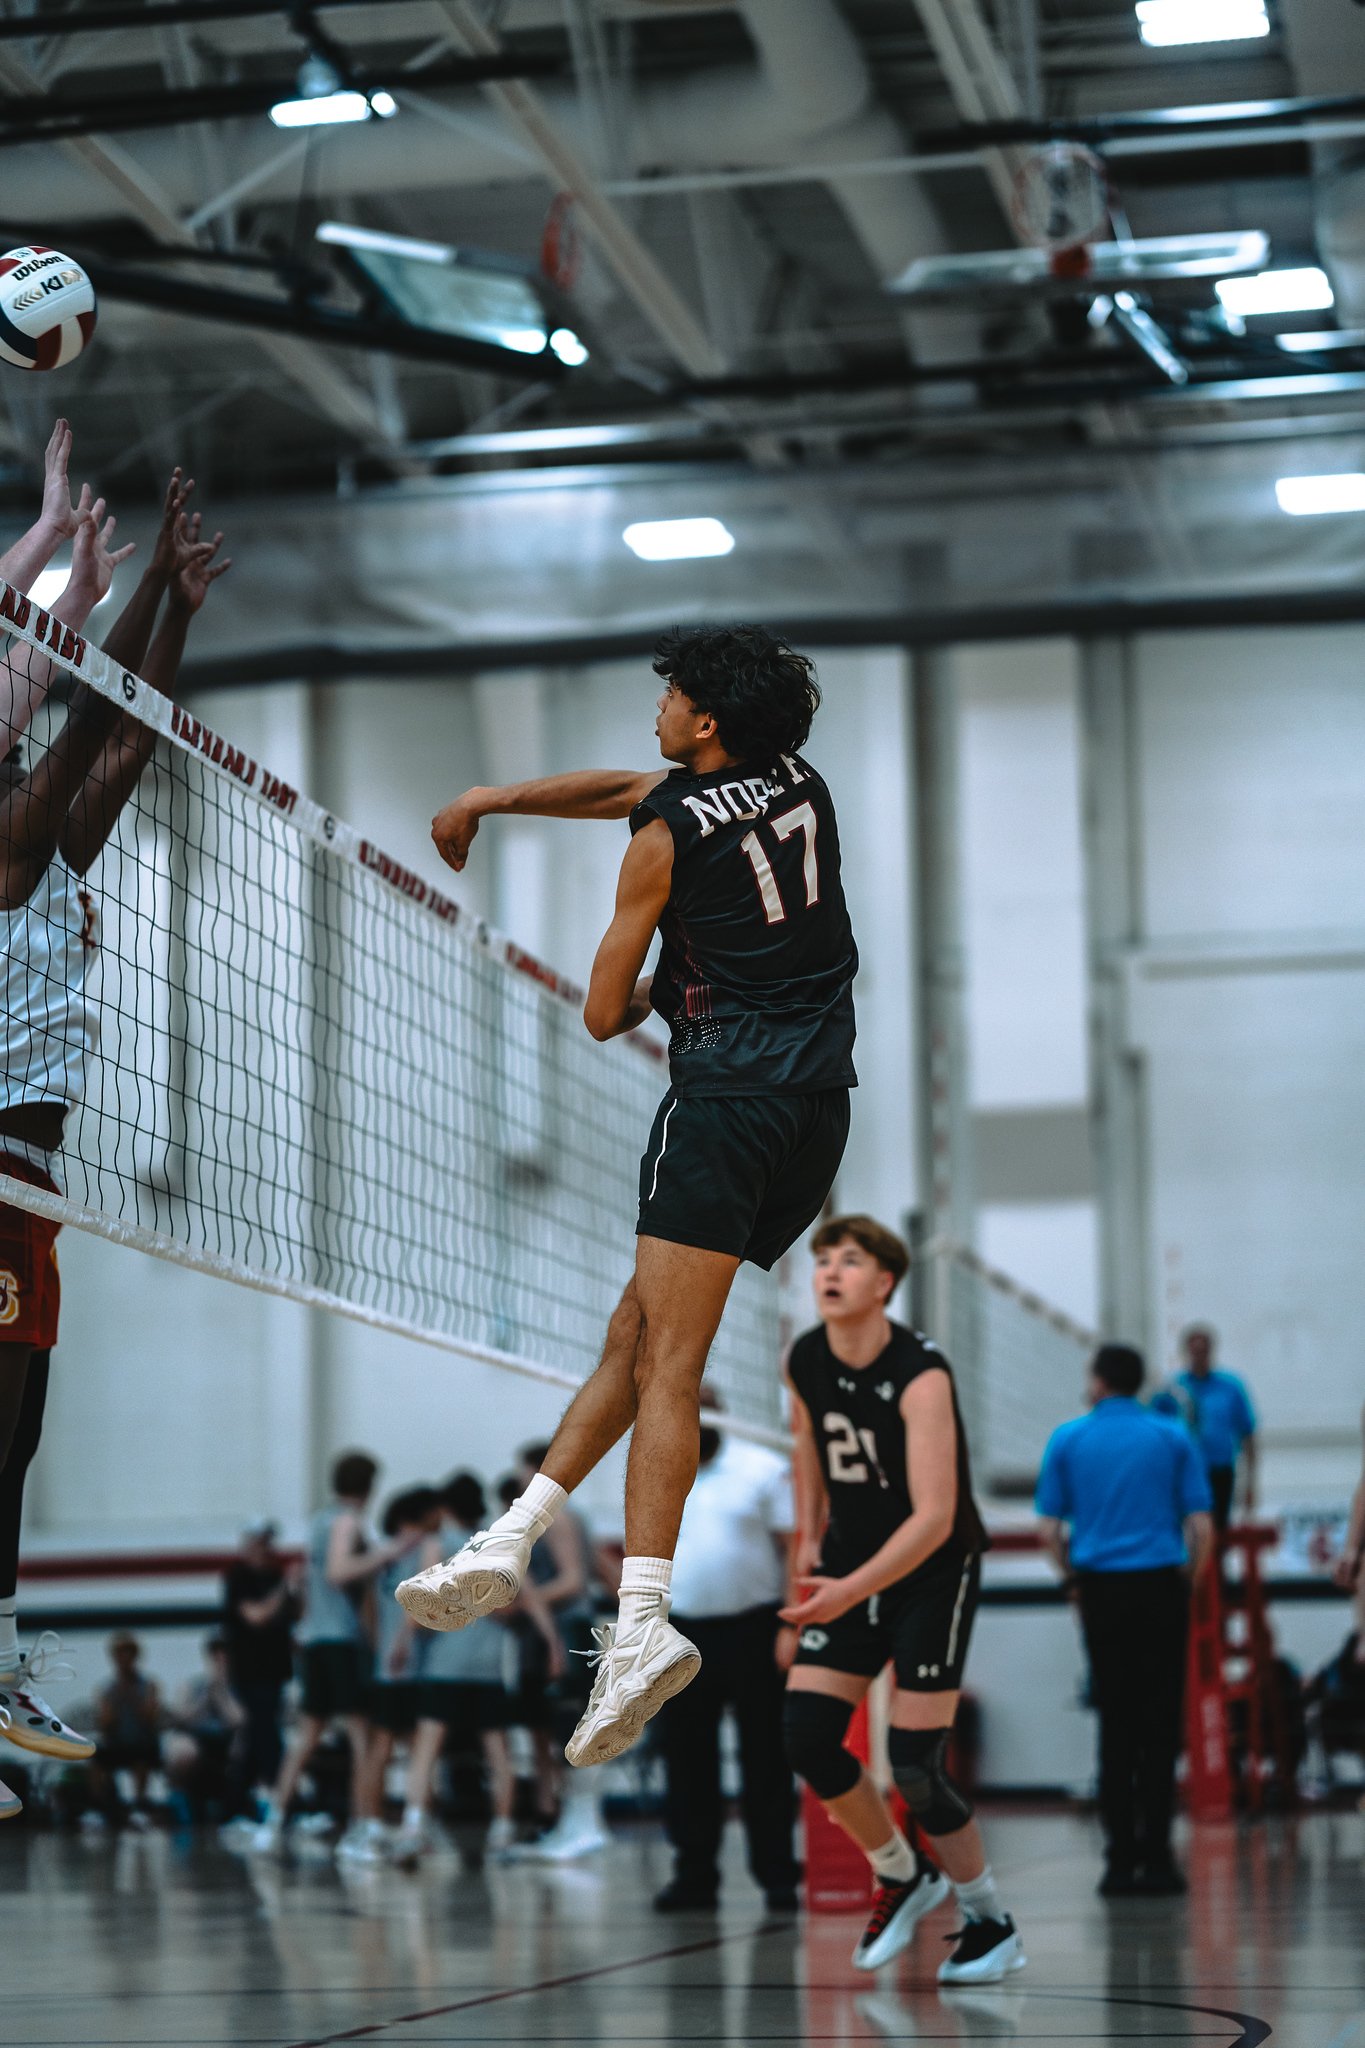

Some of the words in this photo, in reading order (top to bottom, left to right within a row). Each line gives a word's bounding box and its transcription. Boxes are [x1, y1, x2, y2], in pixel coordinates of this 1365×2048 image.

[12, 255, 64, 281] Wilson
[681, 752, 811, 838] NOR
[740, 800, 820, 926] 17
